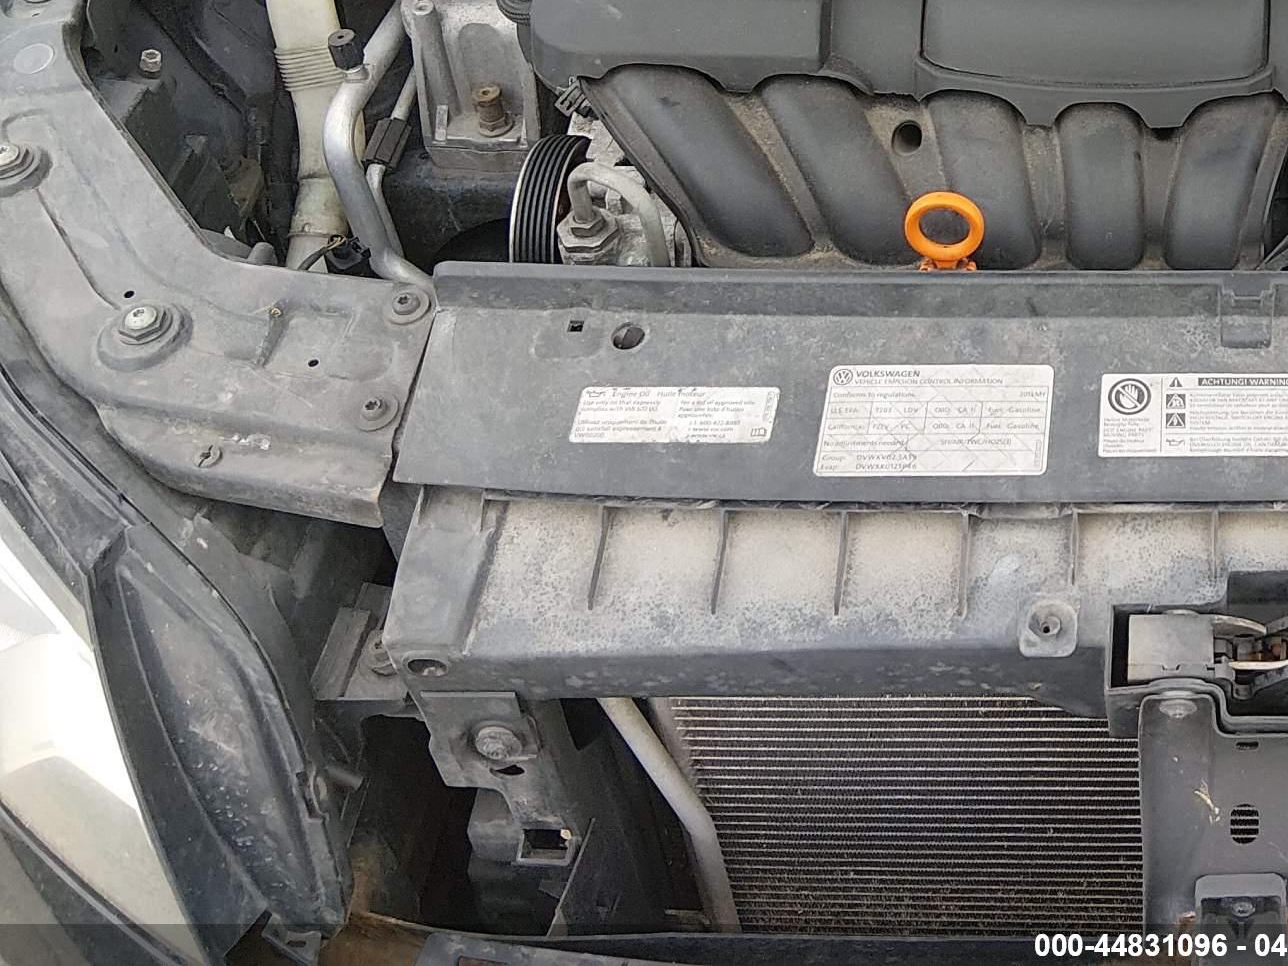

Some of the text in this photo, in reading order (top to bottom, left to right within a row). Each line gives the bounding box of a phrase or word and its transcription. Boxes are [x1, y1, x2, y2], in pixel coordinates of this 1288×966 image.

[856, 370, 920, 378] VOLKSWAGEN
[1201, 378, 1247, 386] ACHTUNG!
[612, 391, 637, 399] Engine
